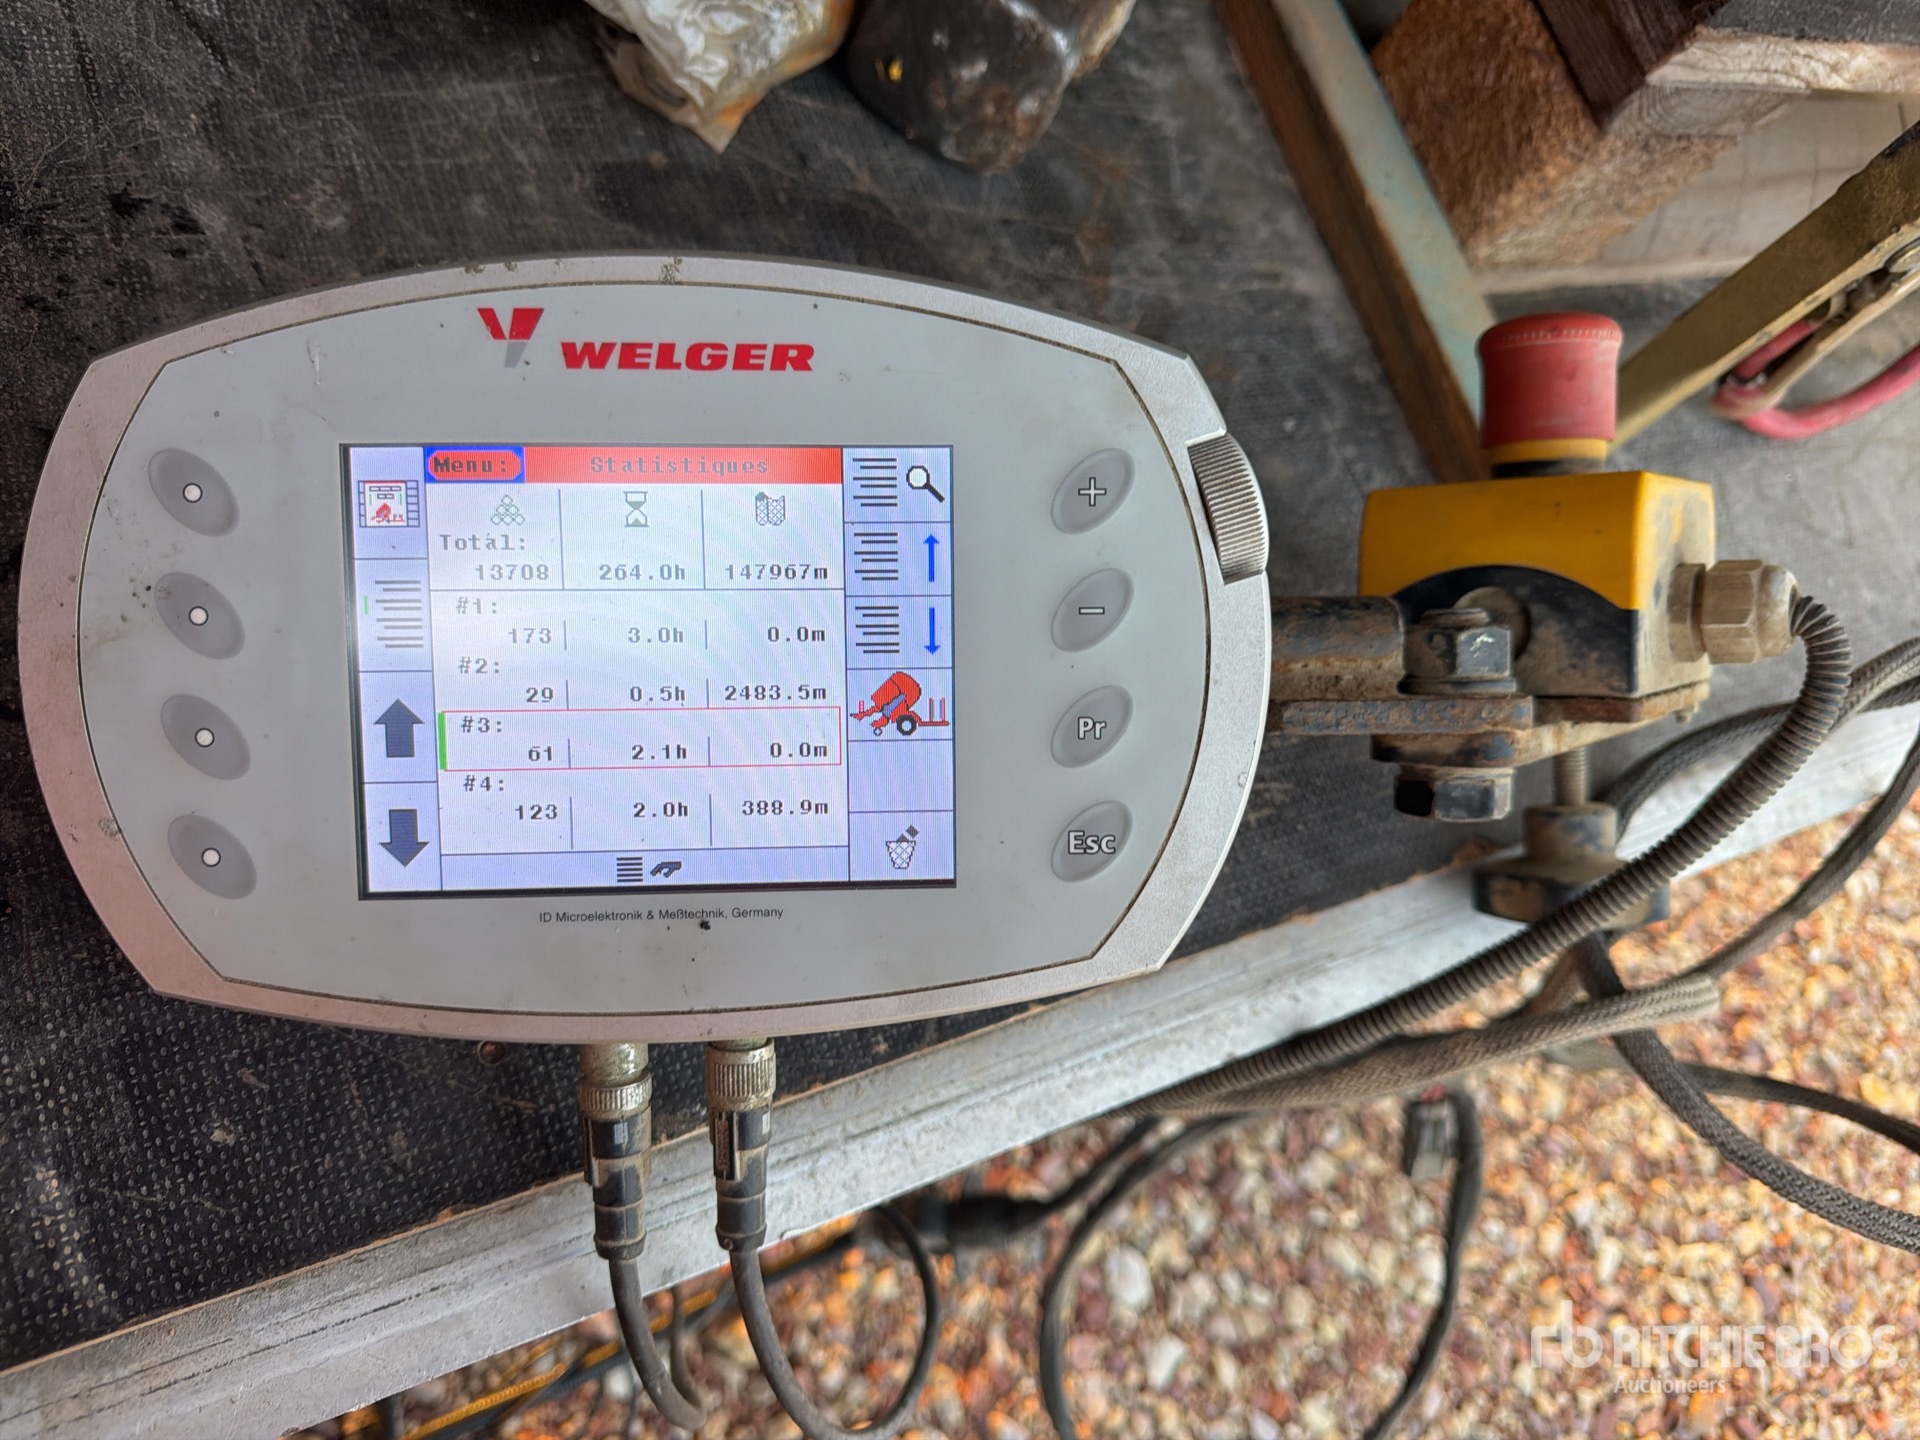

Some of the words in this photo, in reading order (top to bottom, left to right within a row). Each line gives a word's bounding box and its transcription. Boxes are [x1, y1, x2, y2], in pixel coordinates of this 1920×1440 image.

[561, 342, 815, 371] WELGER
[433, 457, 508, 473] Menu:
[590, 456, 769, 477] Statistiques
[439, 533, 527, 551] Total:
[475, 564, 550, 581] 13708
[599, 564, 686, 581] 264.0h
[725, 564, 828, 580] 147967m
[456, 597, 498, 614] #1:
[508, 628, 552, 644] 173
[628, 626, 684, 643] 3.0h
[767, 626, 826, 642] 0.0m
[458, 657, 501, 674] #2:
[525, 687, 554, 703] 29
[630, 685, 686, 702] 0.5h
[724, 684, 827, 701] 2483.5m
[461, 716, 503, 733] #3:
[1077, 716, 1107, 740] Pr
[528, 746, 553, 762] 61
[631, 744, 687, 760] 2.1h
[770, 742, 828, 758] 0.0m
[463, 775, 505, 792] #4:
[515, 804, 559, 820] 123
[633, 802, 689, 818] 2.0h
[742, 800, 829, 816] 388.9m
[1067, 831, 1117, 856] Esc
[539, 912, 552, 923] ID
[555, 910, 644, 922] Microelektronik
[646, 910, 655, 920] &
[658, 909, 728, 920] Meßtechnik,
[731, 907, 784, 919] Germany
